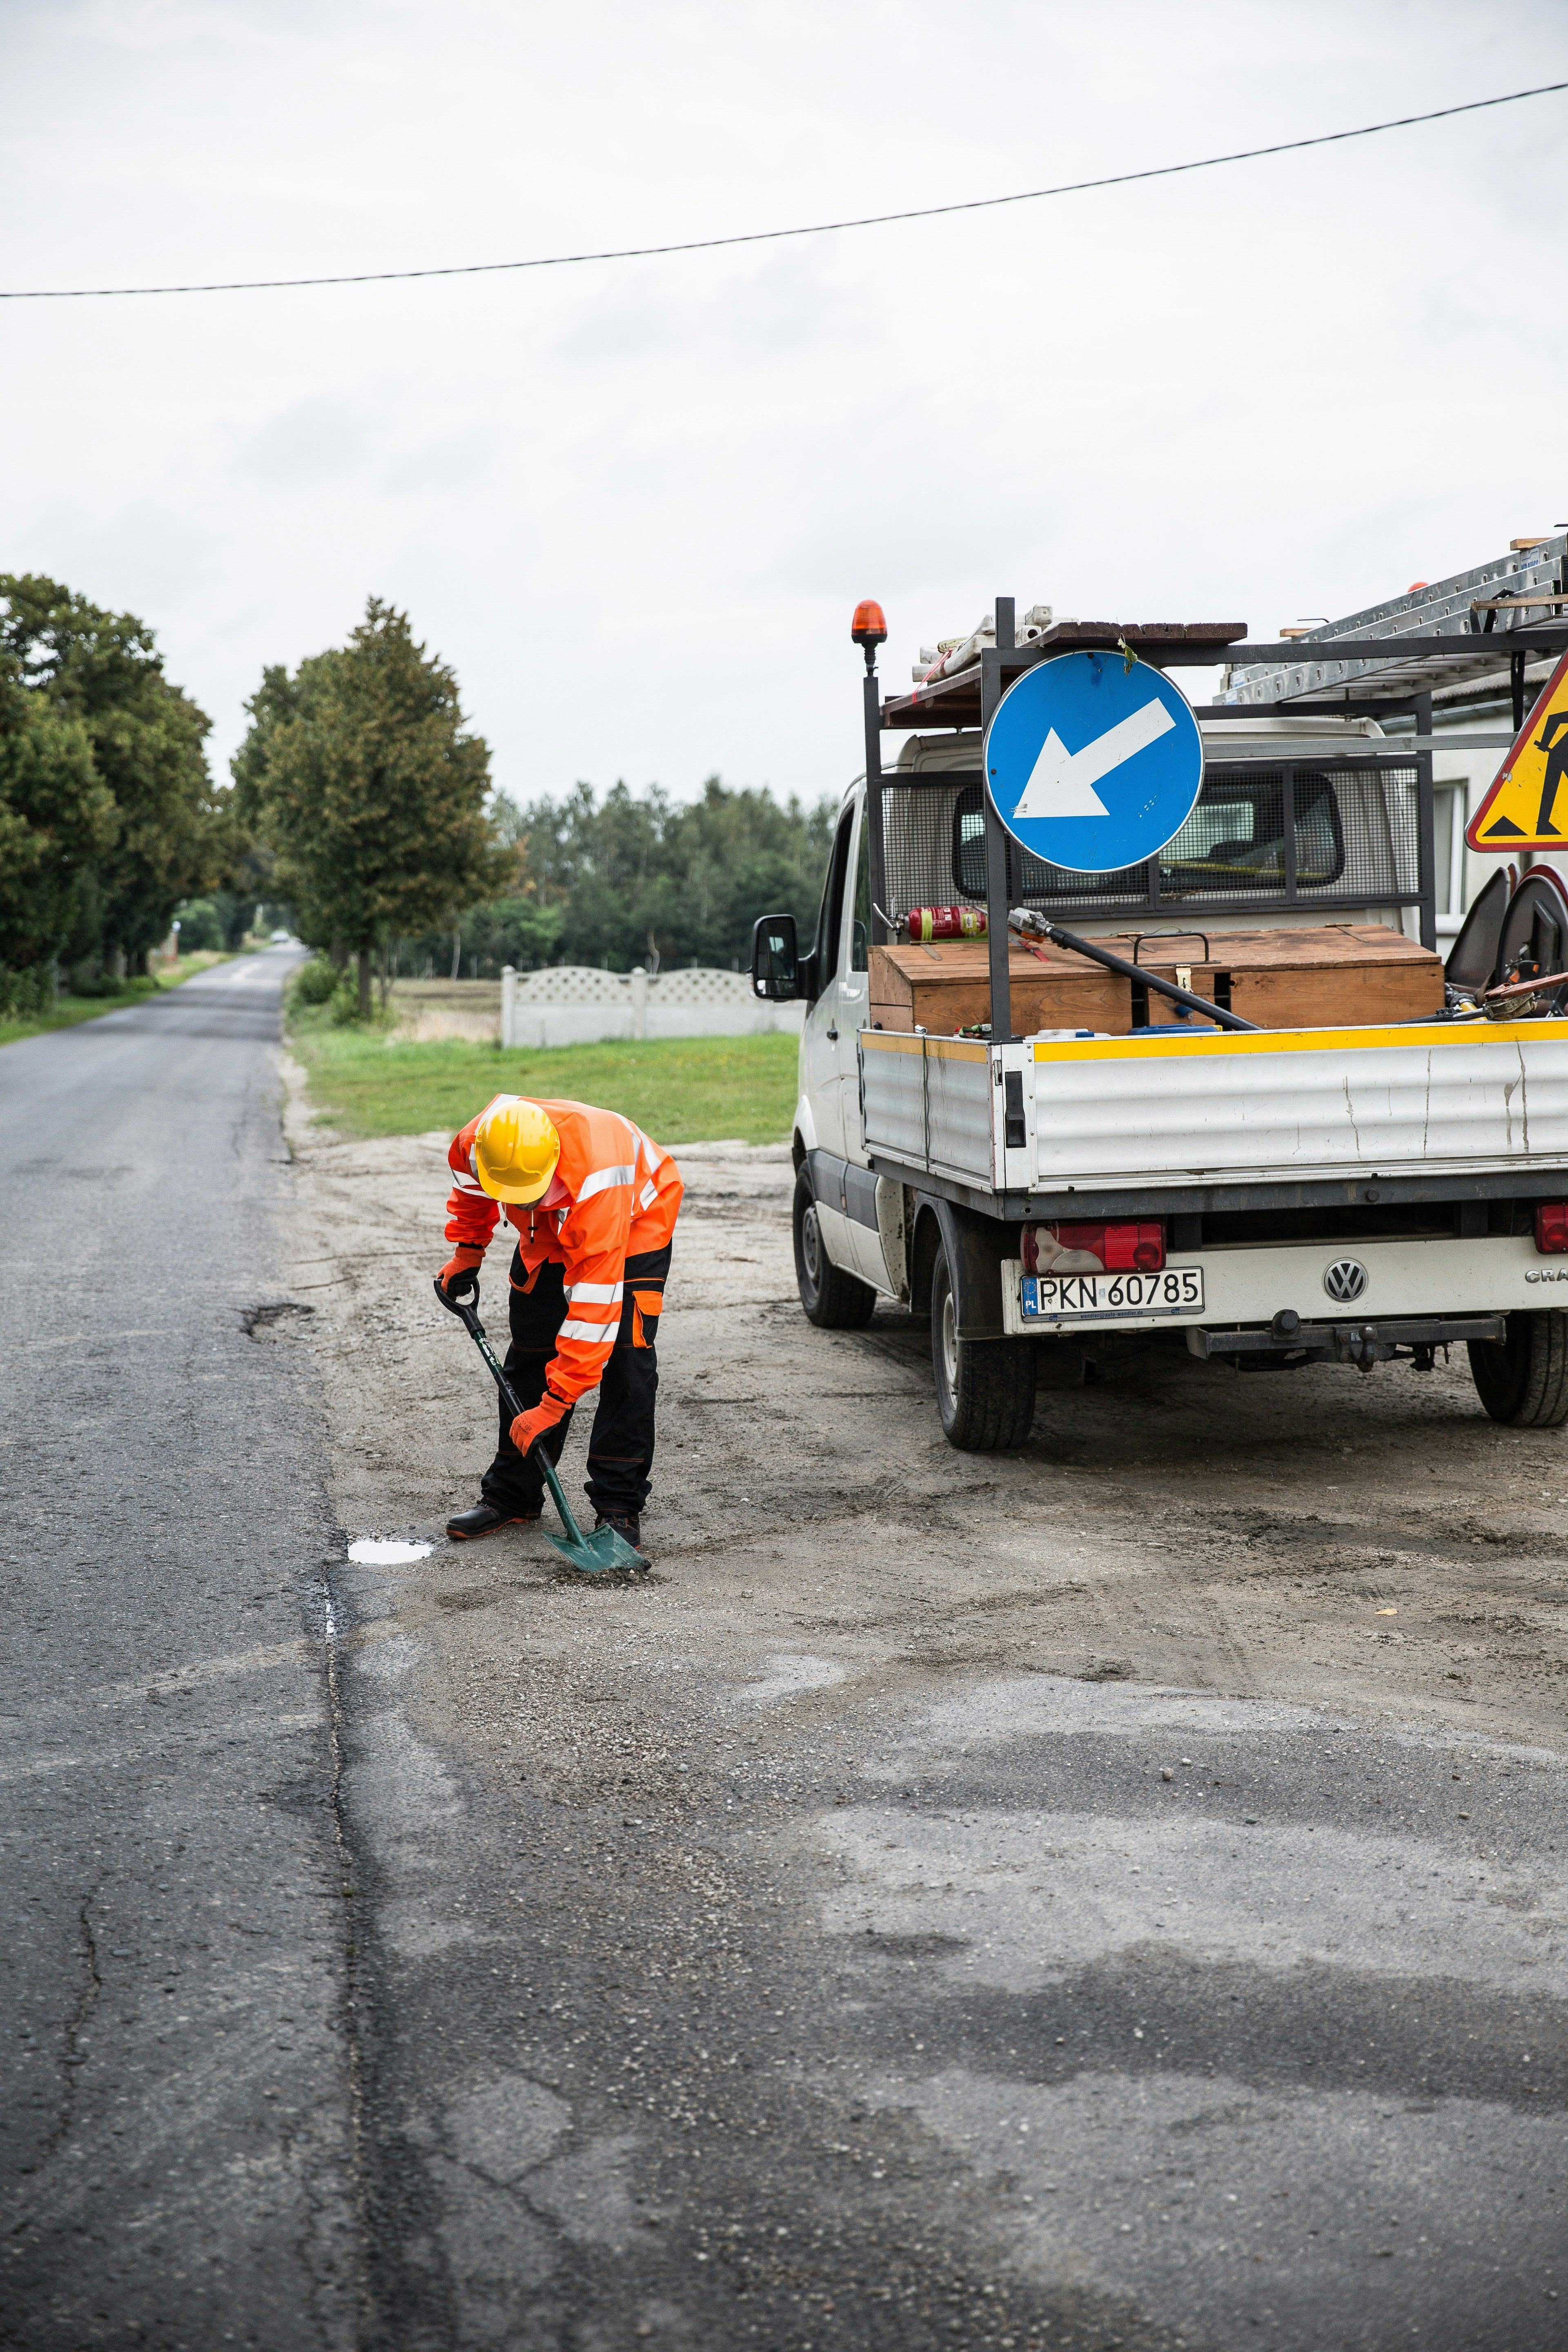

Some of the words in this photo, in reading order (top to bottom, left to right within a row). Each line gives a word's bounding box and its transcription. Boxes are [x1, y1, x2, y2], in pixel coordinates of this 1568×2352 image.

[1040, 1277, 1097, 1310] PKN
[1108, 1272, 1198, 1306] 60785
[1025, 1300, 1036, 1309] PL
